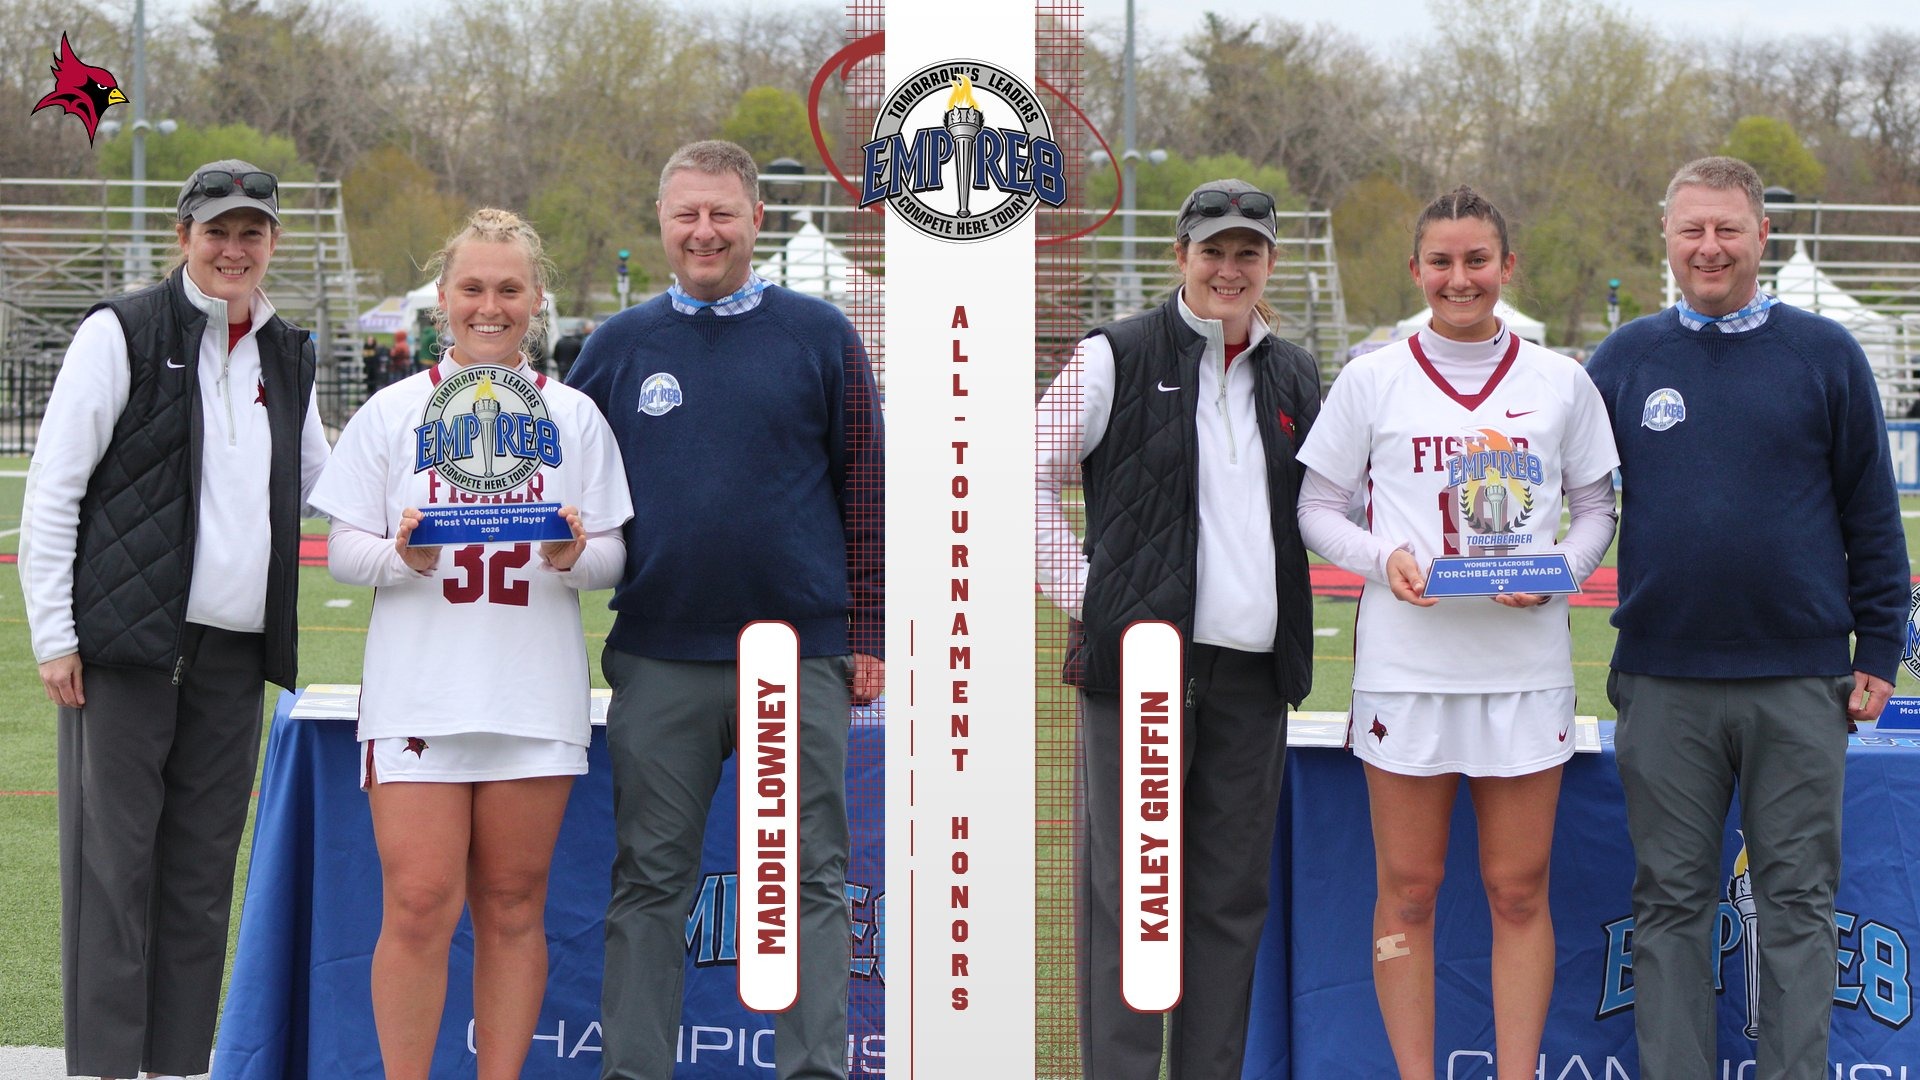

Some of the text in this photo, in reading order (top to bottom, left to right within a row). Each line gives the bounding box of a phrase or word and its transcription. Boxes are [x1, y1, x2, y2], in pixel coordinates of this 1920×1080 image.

[502, 375, 540, 409] LEADERS
[442, 462, 481, 490] COMPETE
[484, 479, 508, 491] HERE
[508, 459, 534, 484] TODAY
[1448, 450, 1544, 489] EMPIRE8
[422, 506, 558, 518] WOMEN'S LACROSSE CHAMPIONSHIP
[434, 515, 546, 527] Most Valuable Player
[1466, 534, 1533, 545] TORCHBEARER
[443, 542, 531, 607] 32
[1437, 567, 1562, 579] TORCHBEARER AWARD
